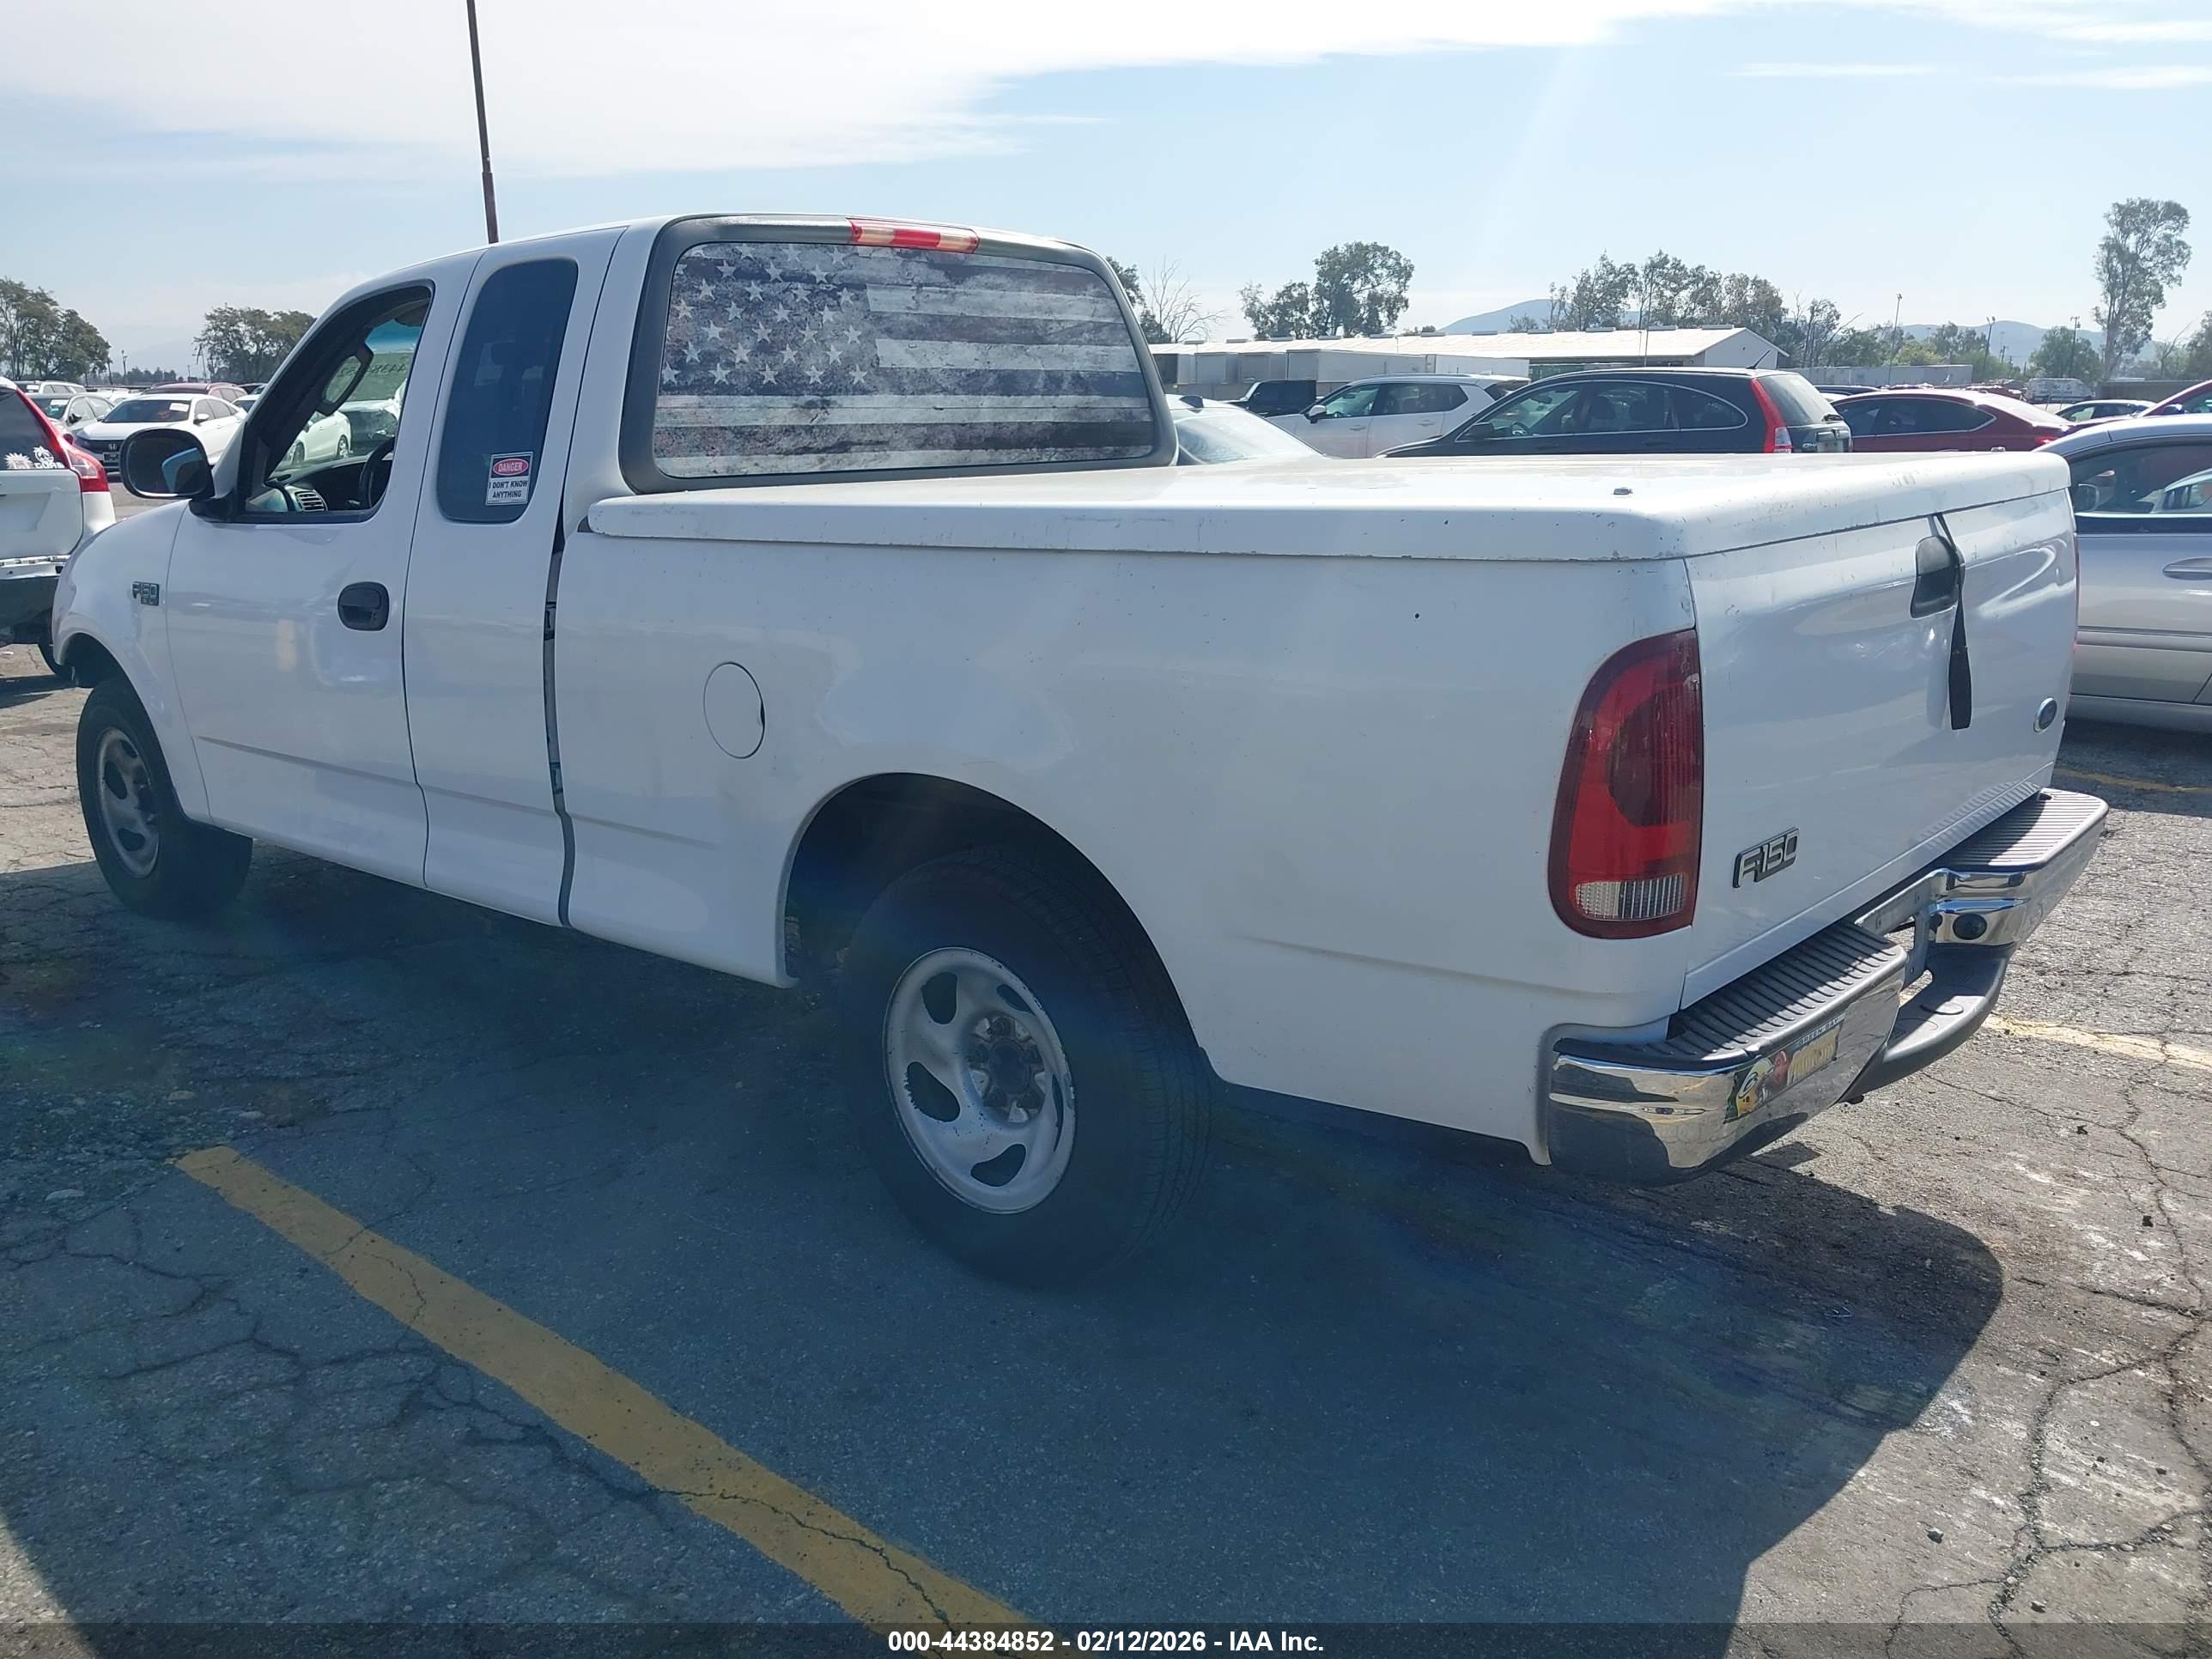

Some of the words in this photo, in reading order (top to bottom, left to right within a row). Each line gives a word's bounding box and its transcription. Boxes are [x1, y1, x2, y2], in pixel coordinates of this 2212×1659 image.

[498, 462, 523, 472] DANGER
[1798, 1028, 1823, 1046] GREEN
[1825, 1018, 1839, 1030] BAY
